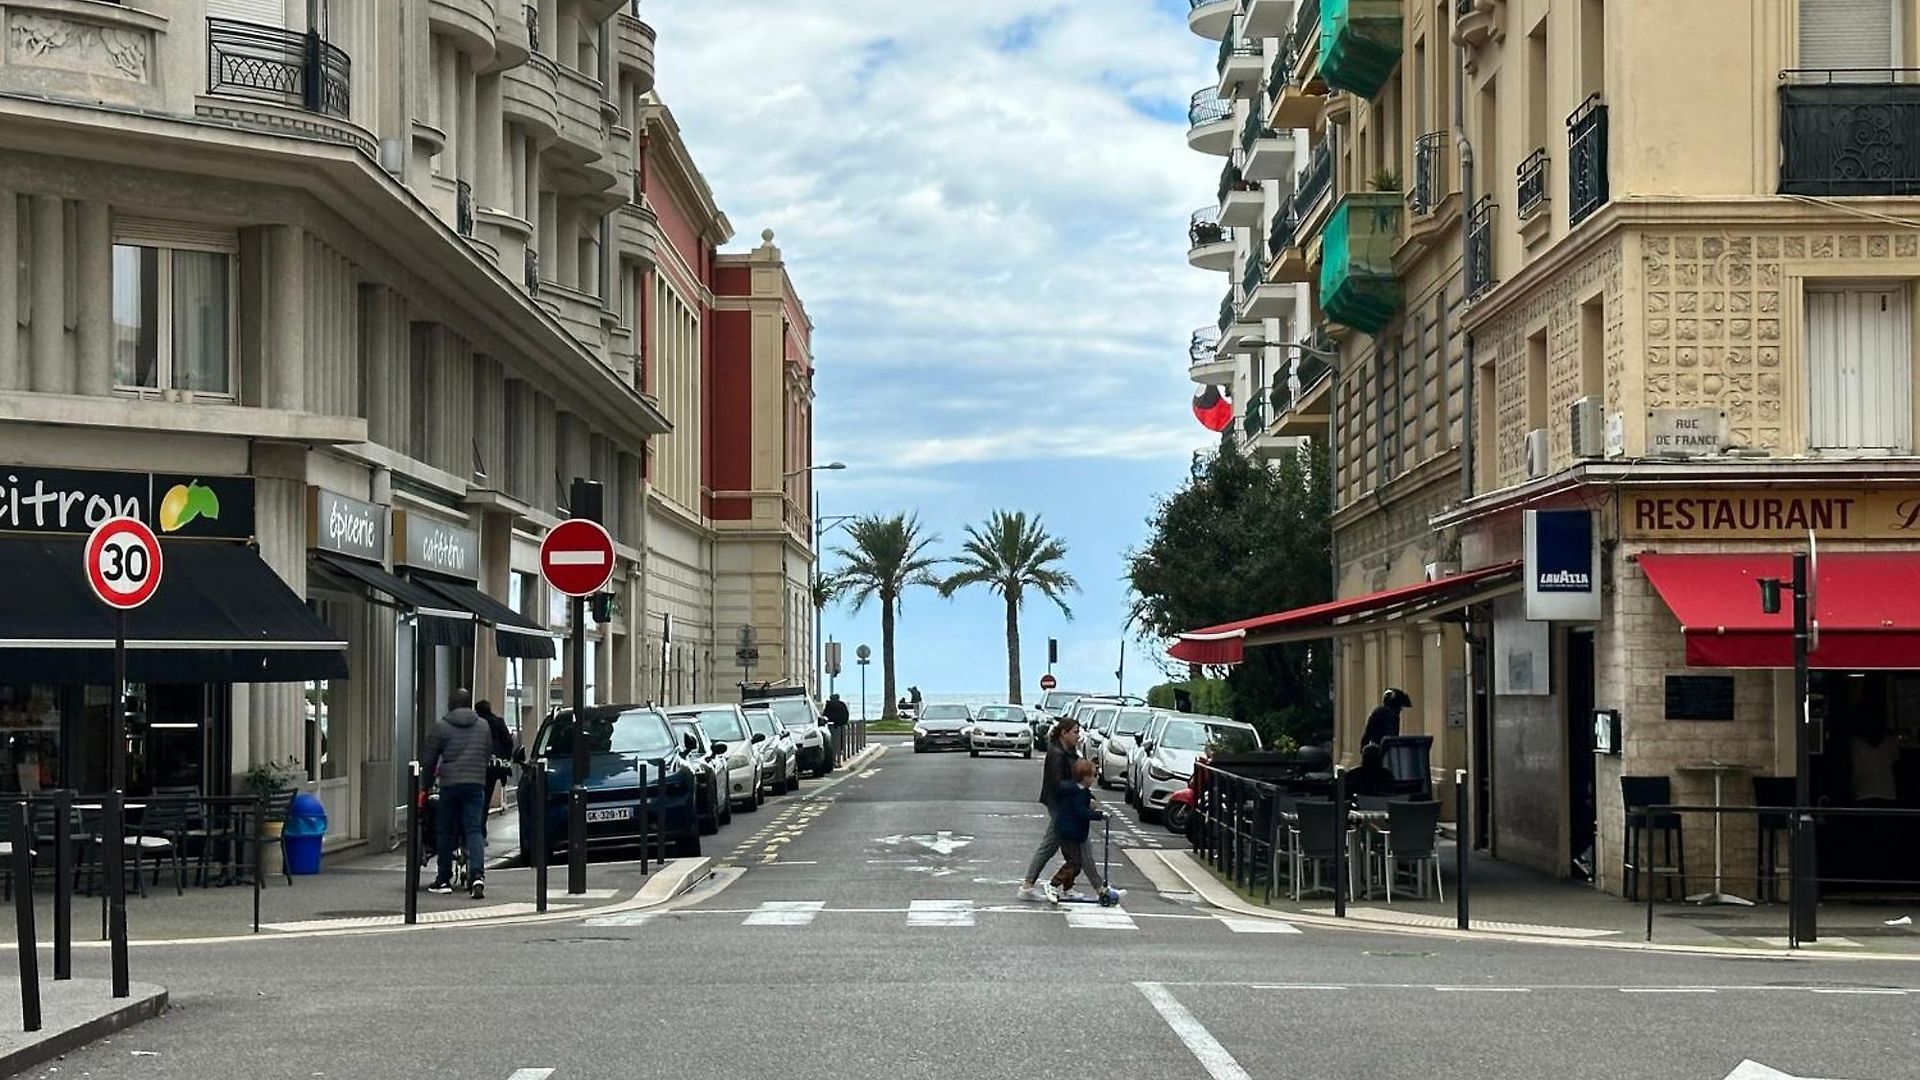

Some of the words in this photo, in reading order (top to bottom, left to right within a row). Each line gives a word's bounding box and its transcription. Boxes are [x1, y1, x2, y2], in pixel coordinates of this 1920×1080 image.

[1675, 419, 1699, 429] RUE
[1656, 435, 1670, 445] DE
[1675, 435, 1719, 445] FRANCE
[329, 500, 375, 549] épicerie
[1635, 498, 1854, 530] RESTAURANT
[103, 543, 148, 582] 30
[1540, 570, 1588, 583] LAVAZZA
